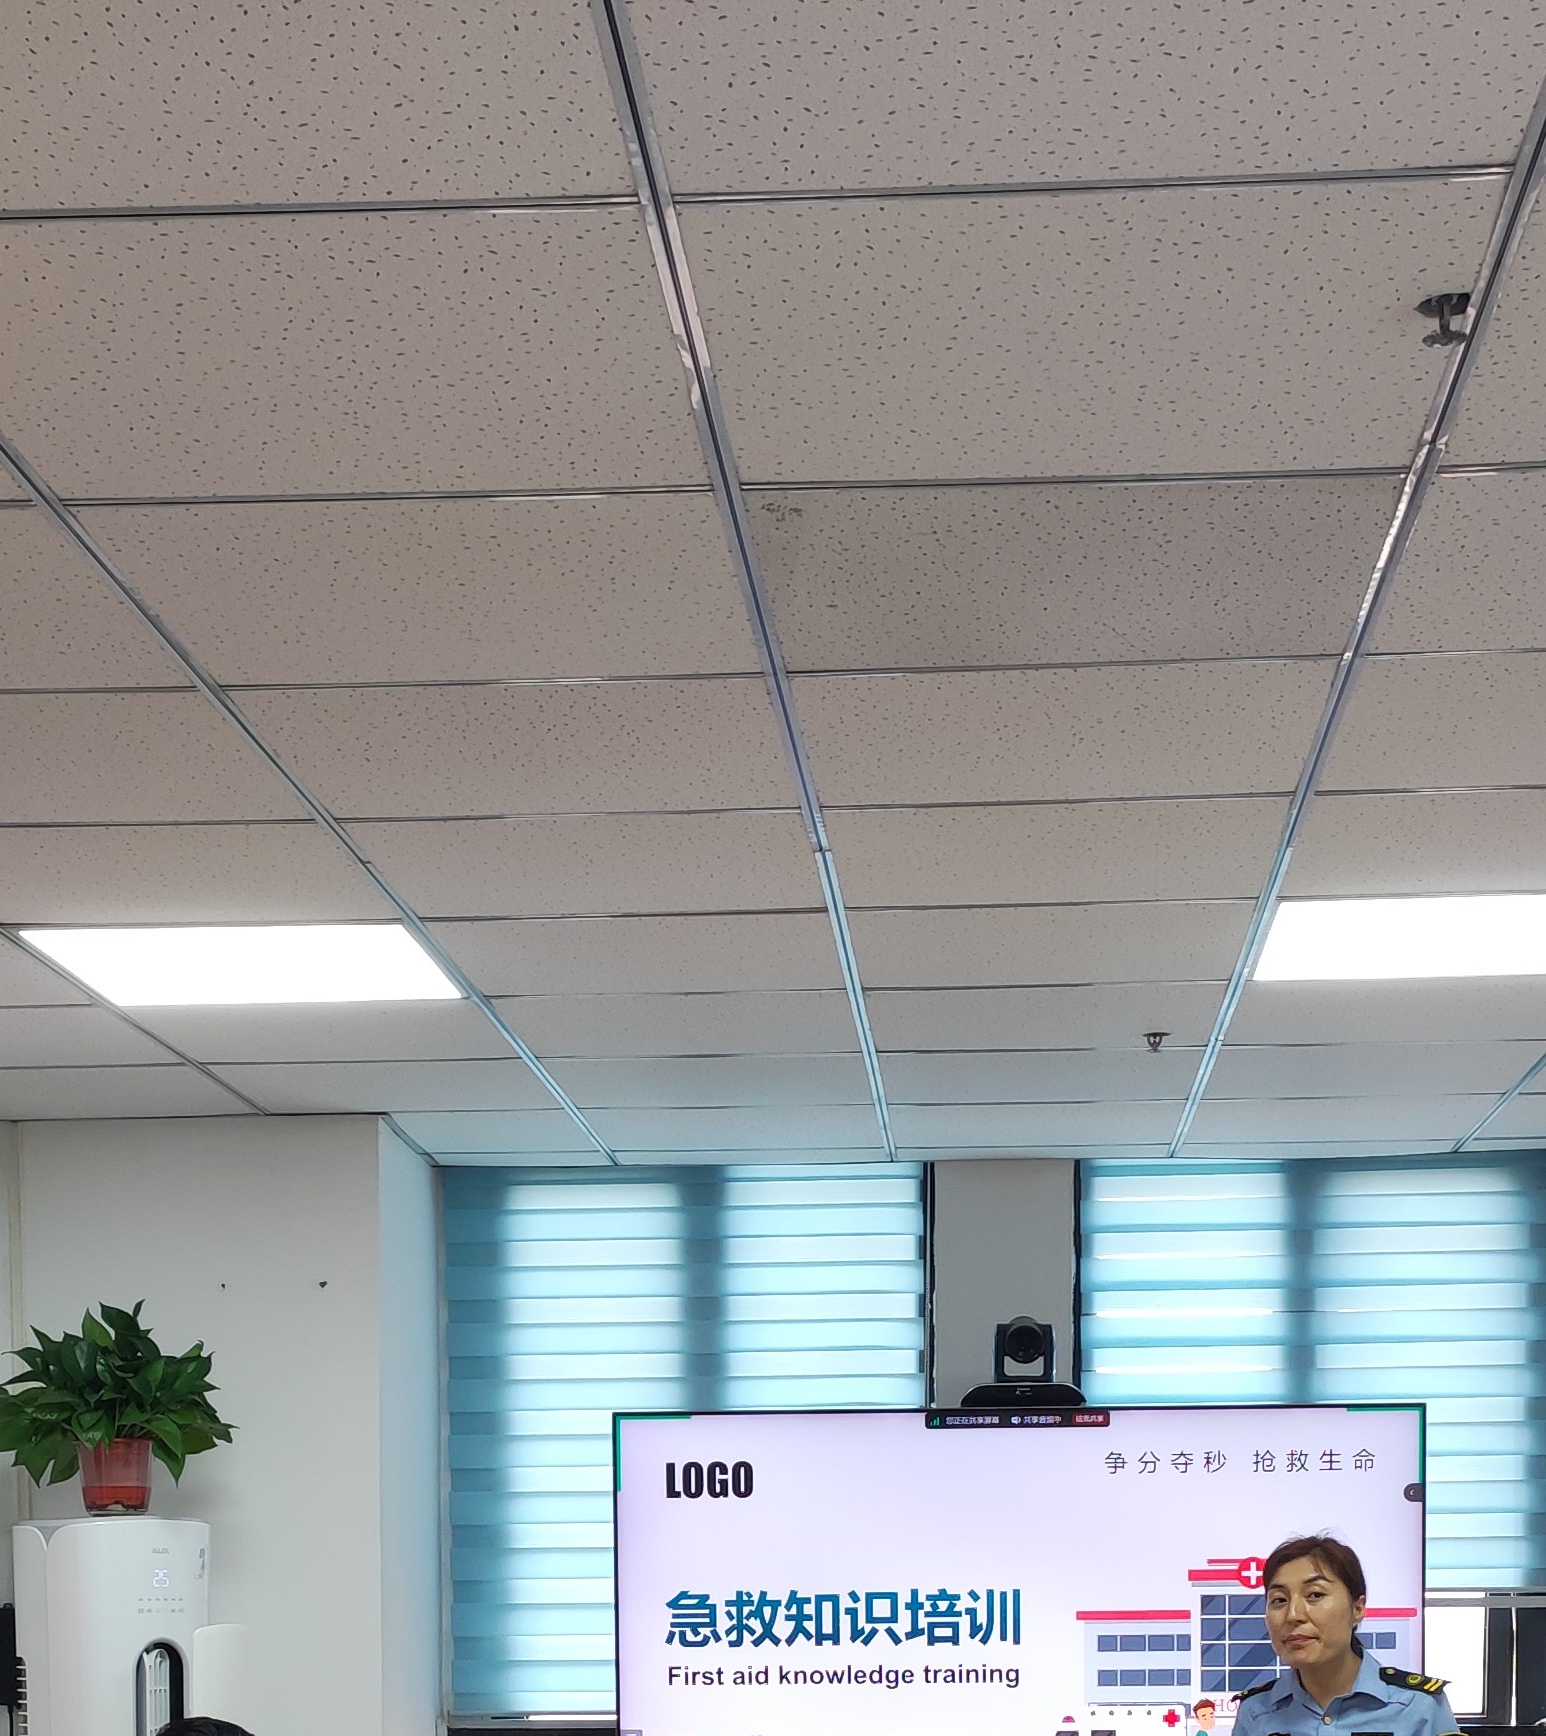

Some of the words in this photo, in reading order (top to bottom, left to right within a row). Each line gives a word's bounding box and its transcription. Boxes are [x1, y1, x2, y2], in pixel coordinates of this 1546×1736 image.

[1104, 1450, 1227, 1474] 争分夺秒
[1252, 1448, 1376, 1473] 抢救生命
[665, 1460, 754, 1499] LOGO
[153, 1569, 169, 1587] 25
[664, 1588, 1022, 1648] 急救知识培训
[667, 1665, 725, 1686] First
[732, 1665, 769, 1686] aid
[778, 1664, 915, 1690] knowledge
[923, 1663, 1021, 1689] training
